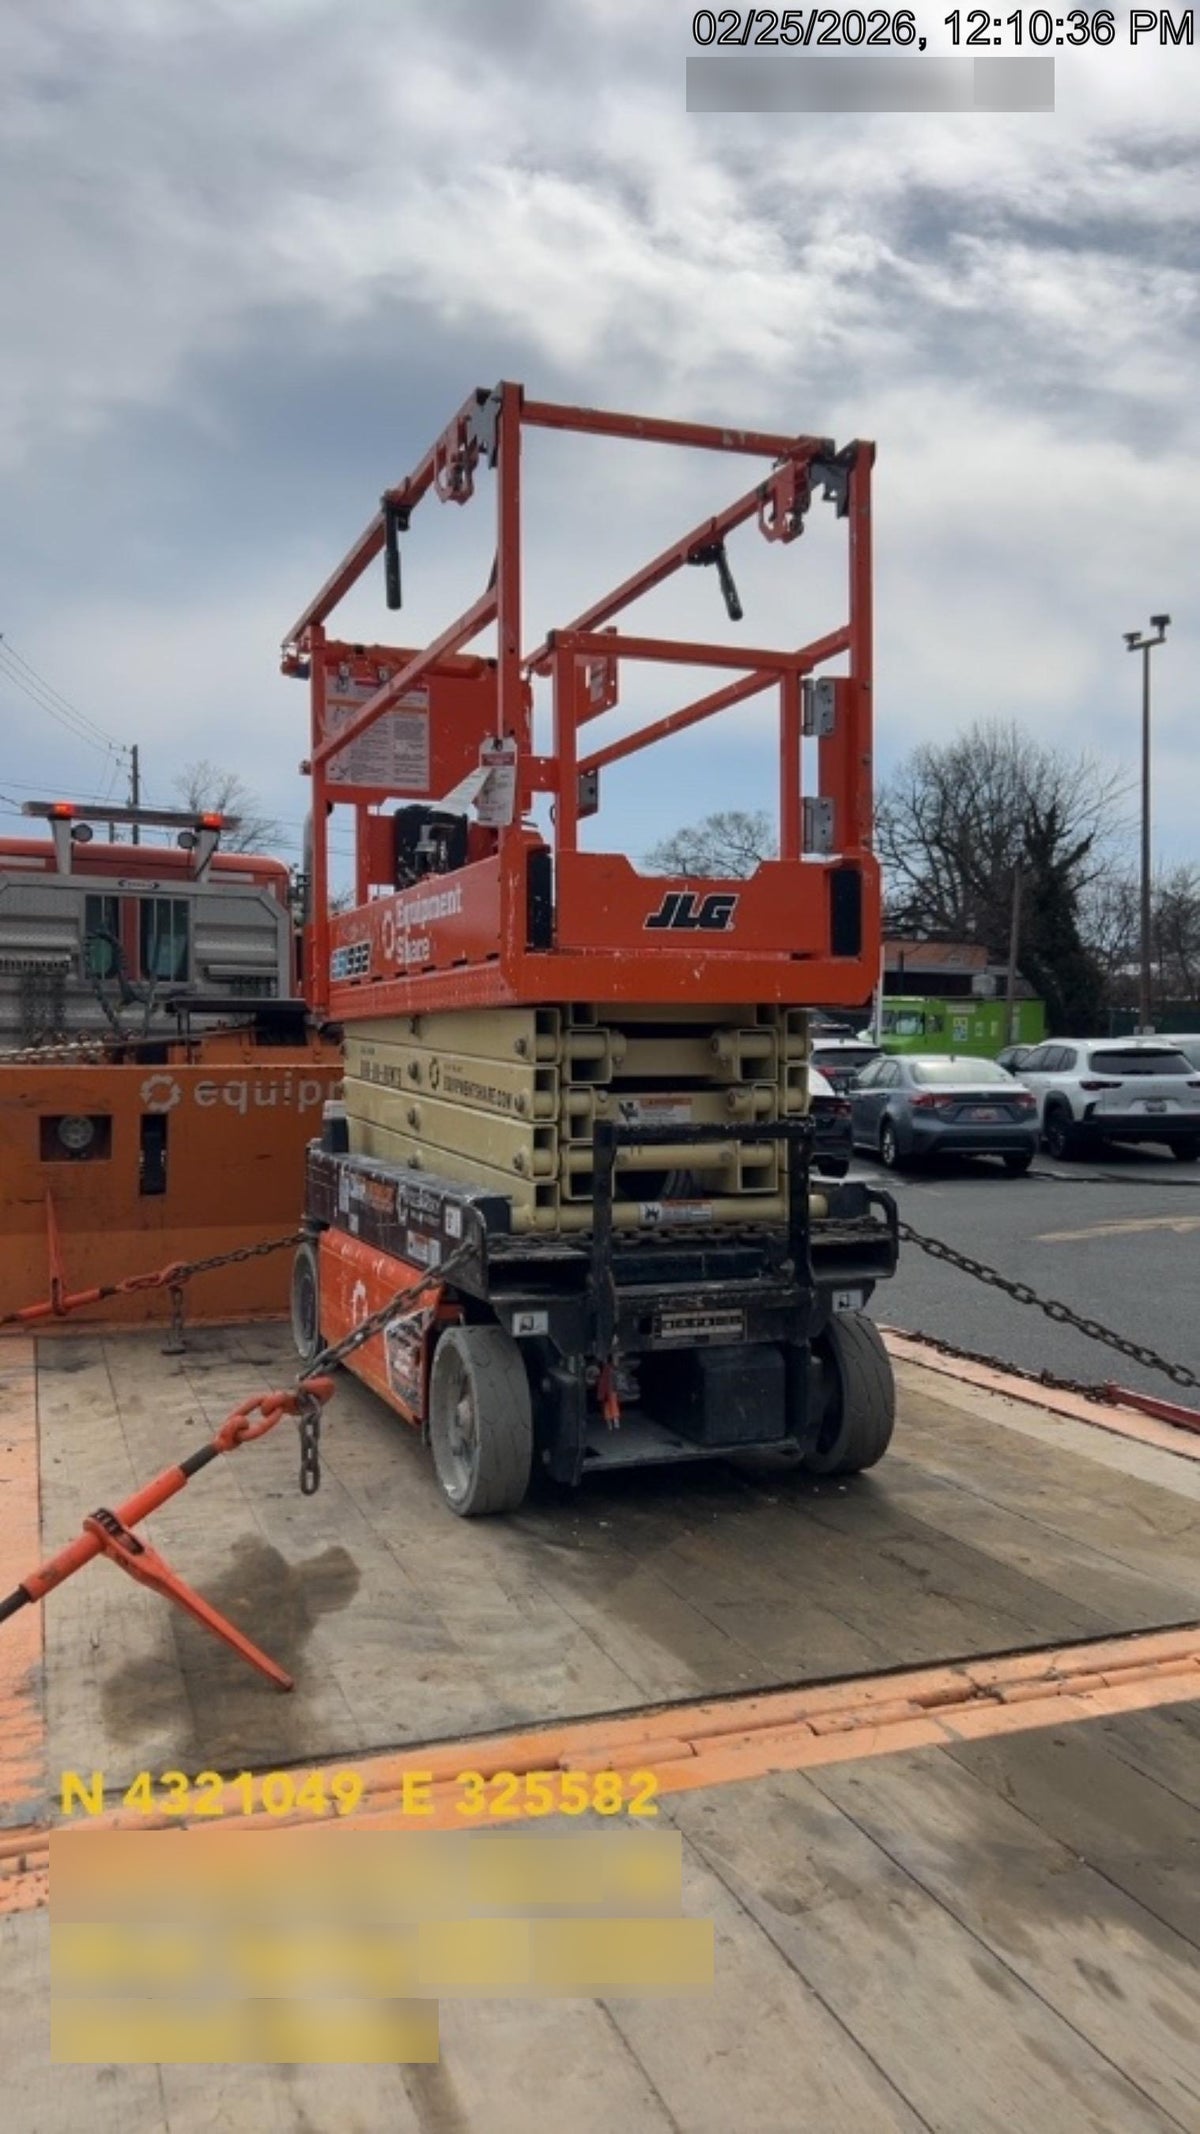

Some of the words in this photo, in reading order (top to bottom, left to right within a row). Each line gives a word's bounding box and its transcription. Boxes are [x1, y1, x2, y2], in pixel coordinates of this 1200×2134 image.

[396, 882, 463, 932] Equipment
[642, 891, 740, 932] JLG
[397, 935, 431, 965] Share
